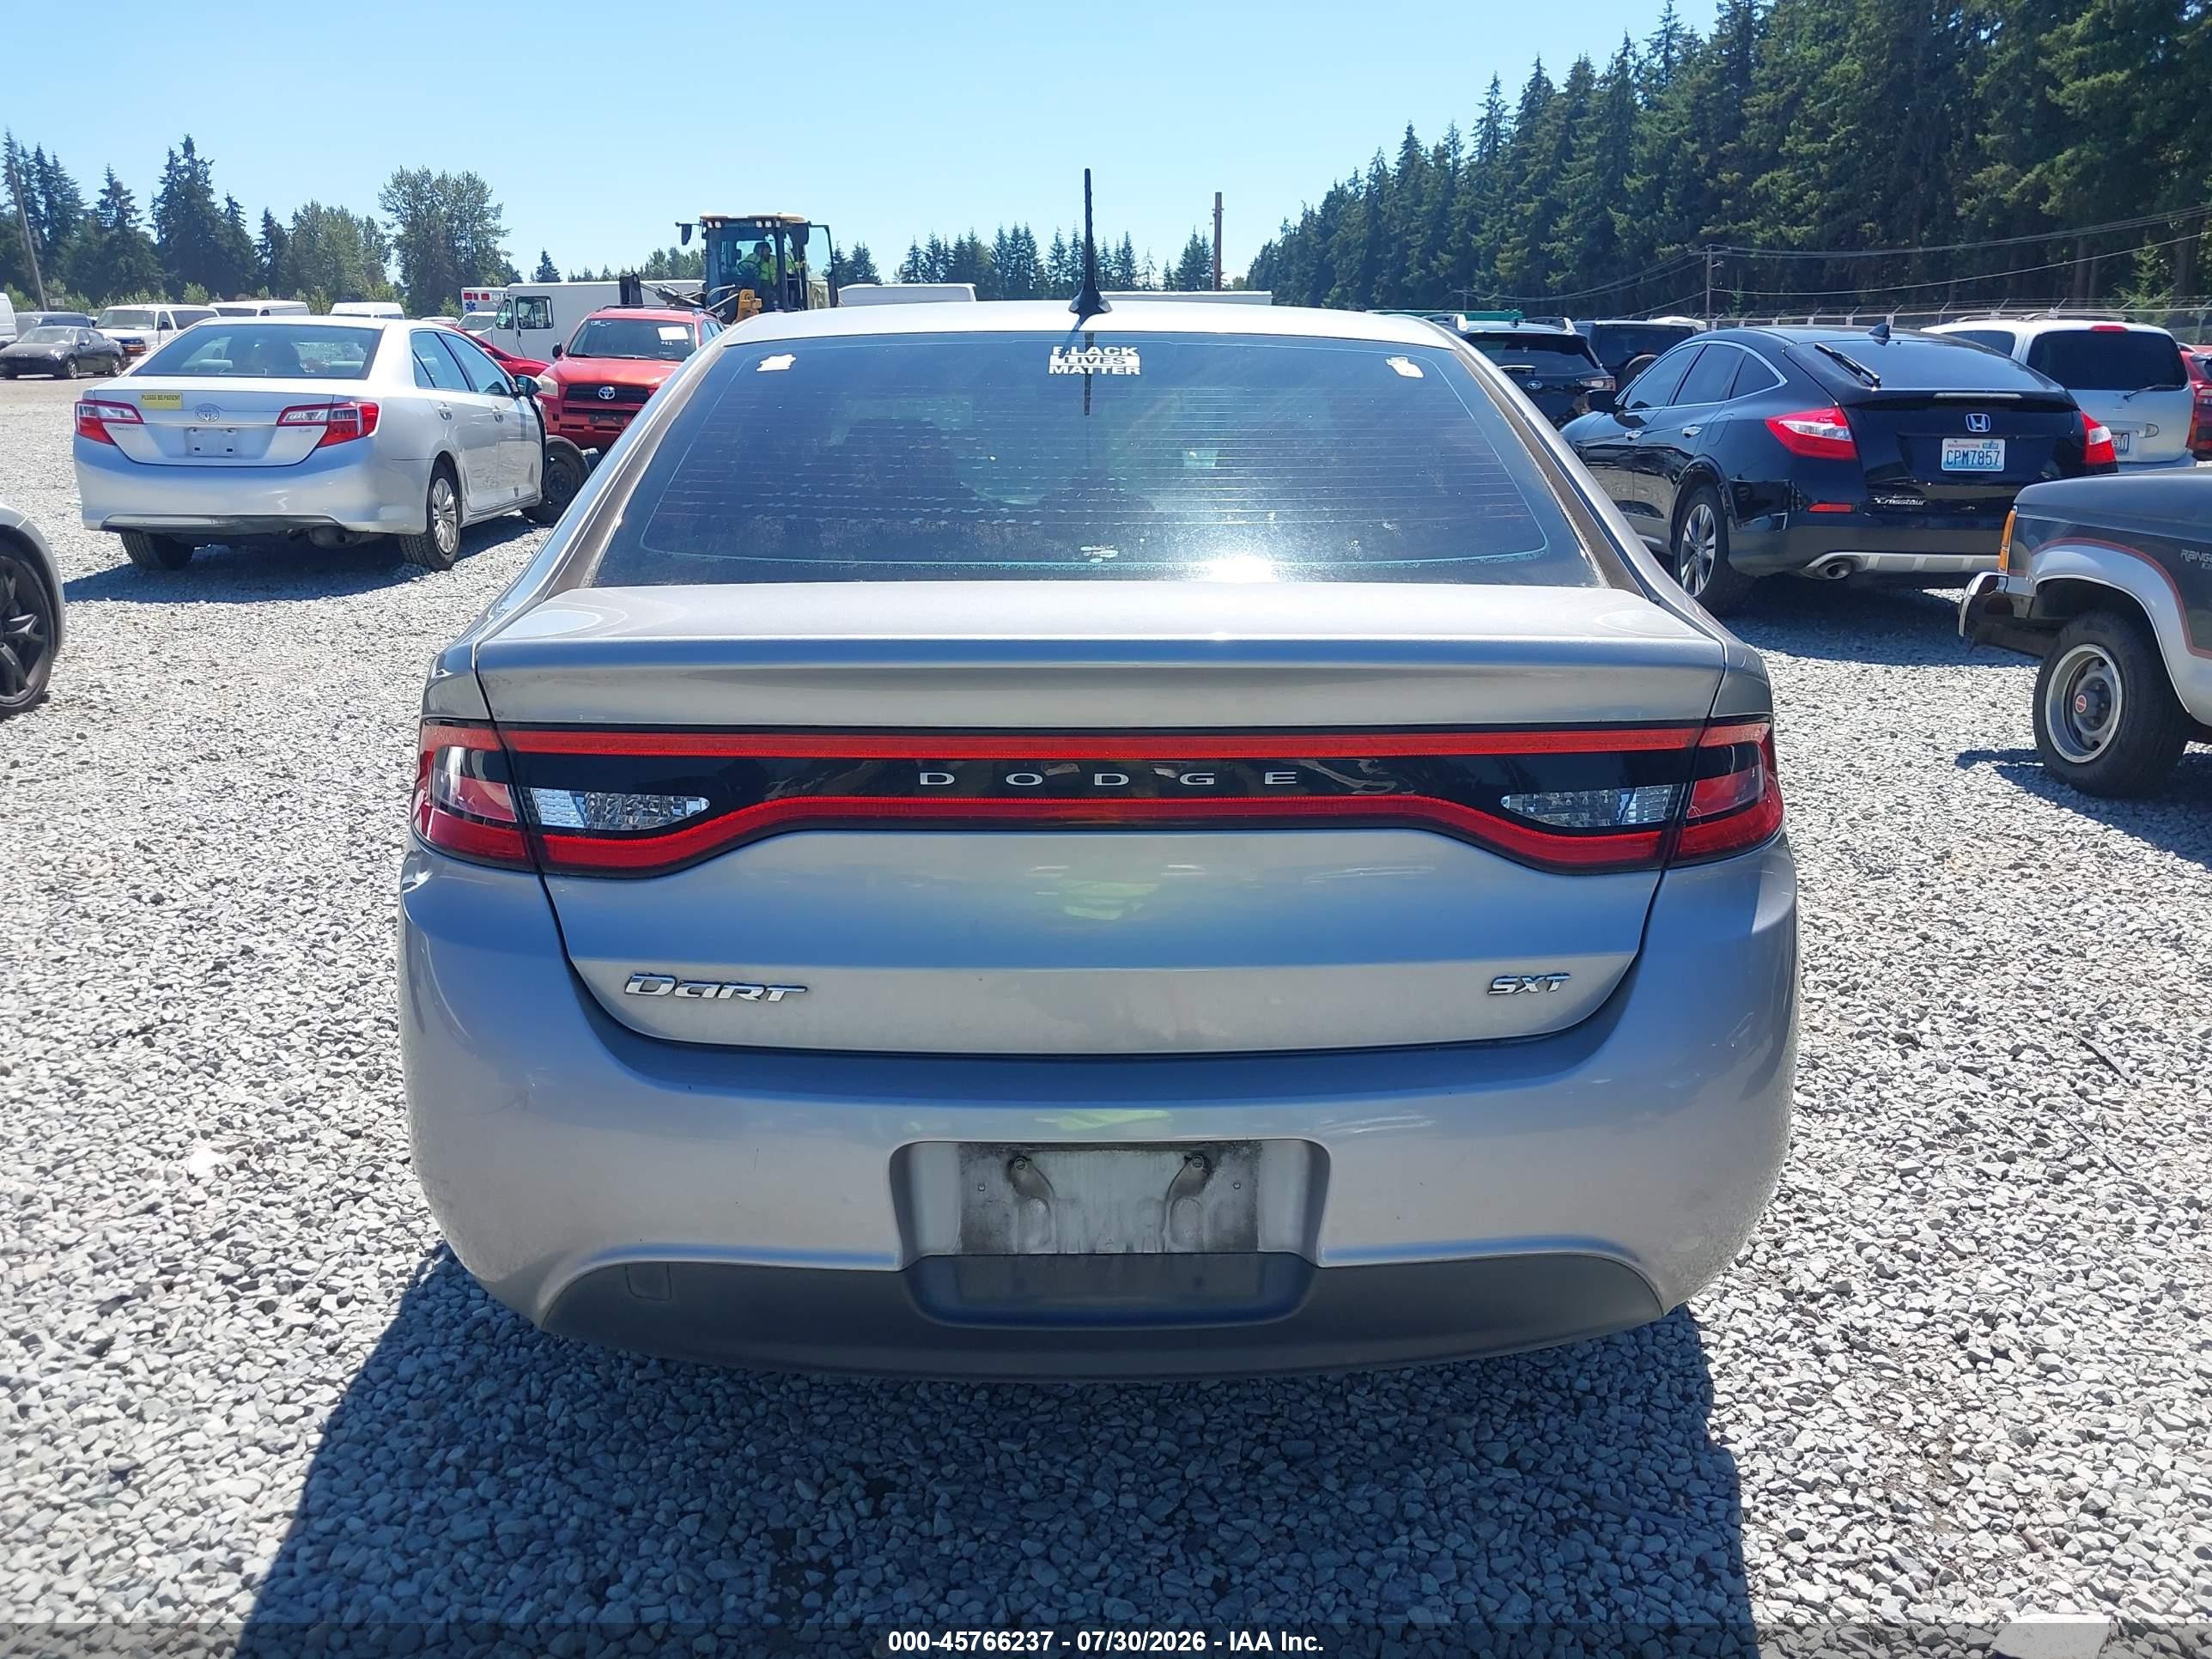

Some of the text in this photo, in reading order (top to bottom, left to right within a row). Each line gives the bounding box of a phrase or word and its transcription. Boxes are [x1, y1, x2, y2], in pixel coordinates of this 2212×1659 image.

[1048, 366, 1141, 375] MATTER
[1946, 449, 2000, 466] CPM7857
[919, 771, 1297, 786] DODGE
[1487, 972, 1571, 995] SXT
